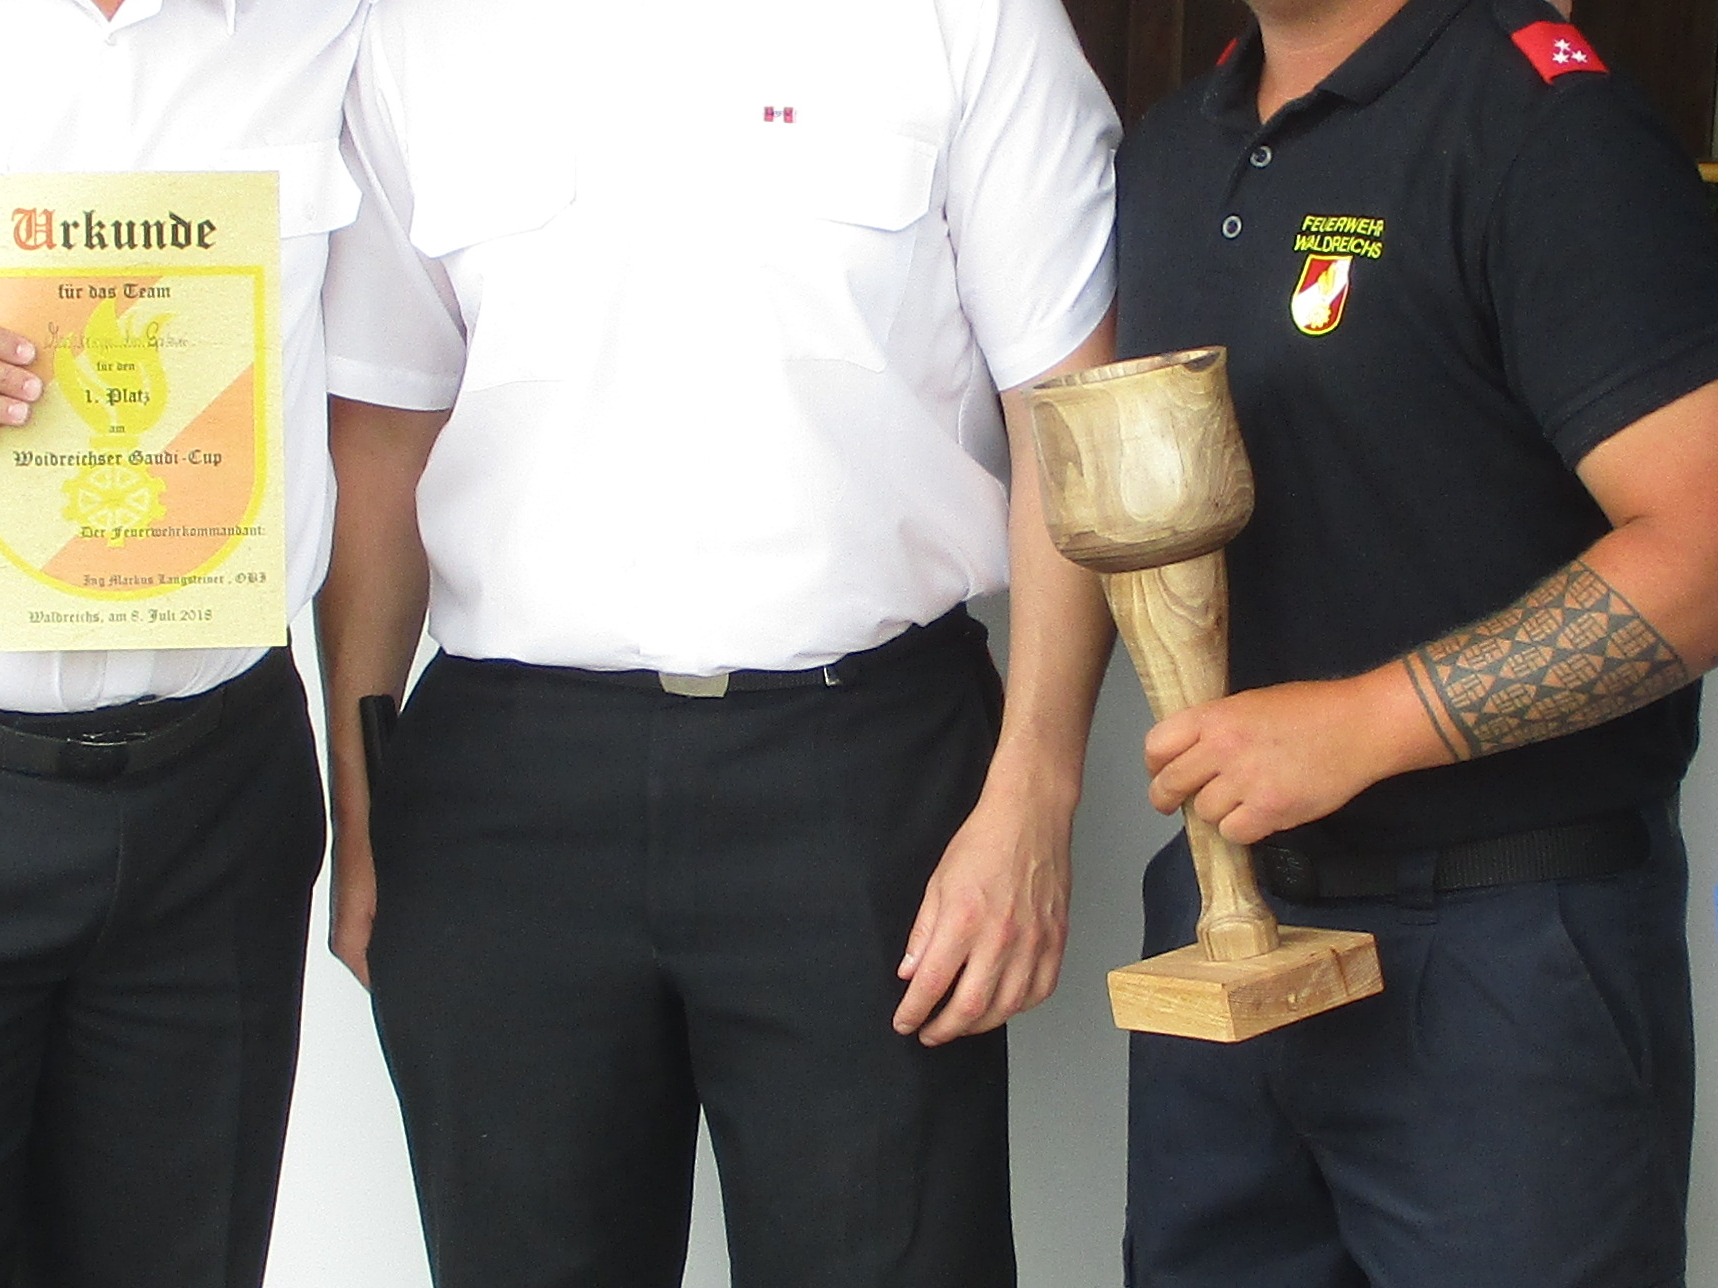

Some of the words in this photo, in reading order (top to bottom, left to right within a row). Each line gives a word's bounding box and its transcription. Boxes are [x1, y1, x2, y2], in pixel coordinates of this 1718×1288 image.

[11, 206, 217, 253] Urkunde
[1301, 215, 1385, 238] FEUERWEHR
[1293, 233, 1384, 259] WALDREICHS
[58, 284, 83, 300] für
[88, 284, 117, 300] das
[123, 283, 171, 300] Team
[85, 389, 100, 404] 1.
[106, 388, 150, 406] Platz
[108, 425, 126, 434] am
[81, 525, 106, 538] Der
[108, 613, 128, 623] am
[179, 609, 214, 623] 2018
